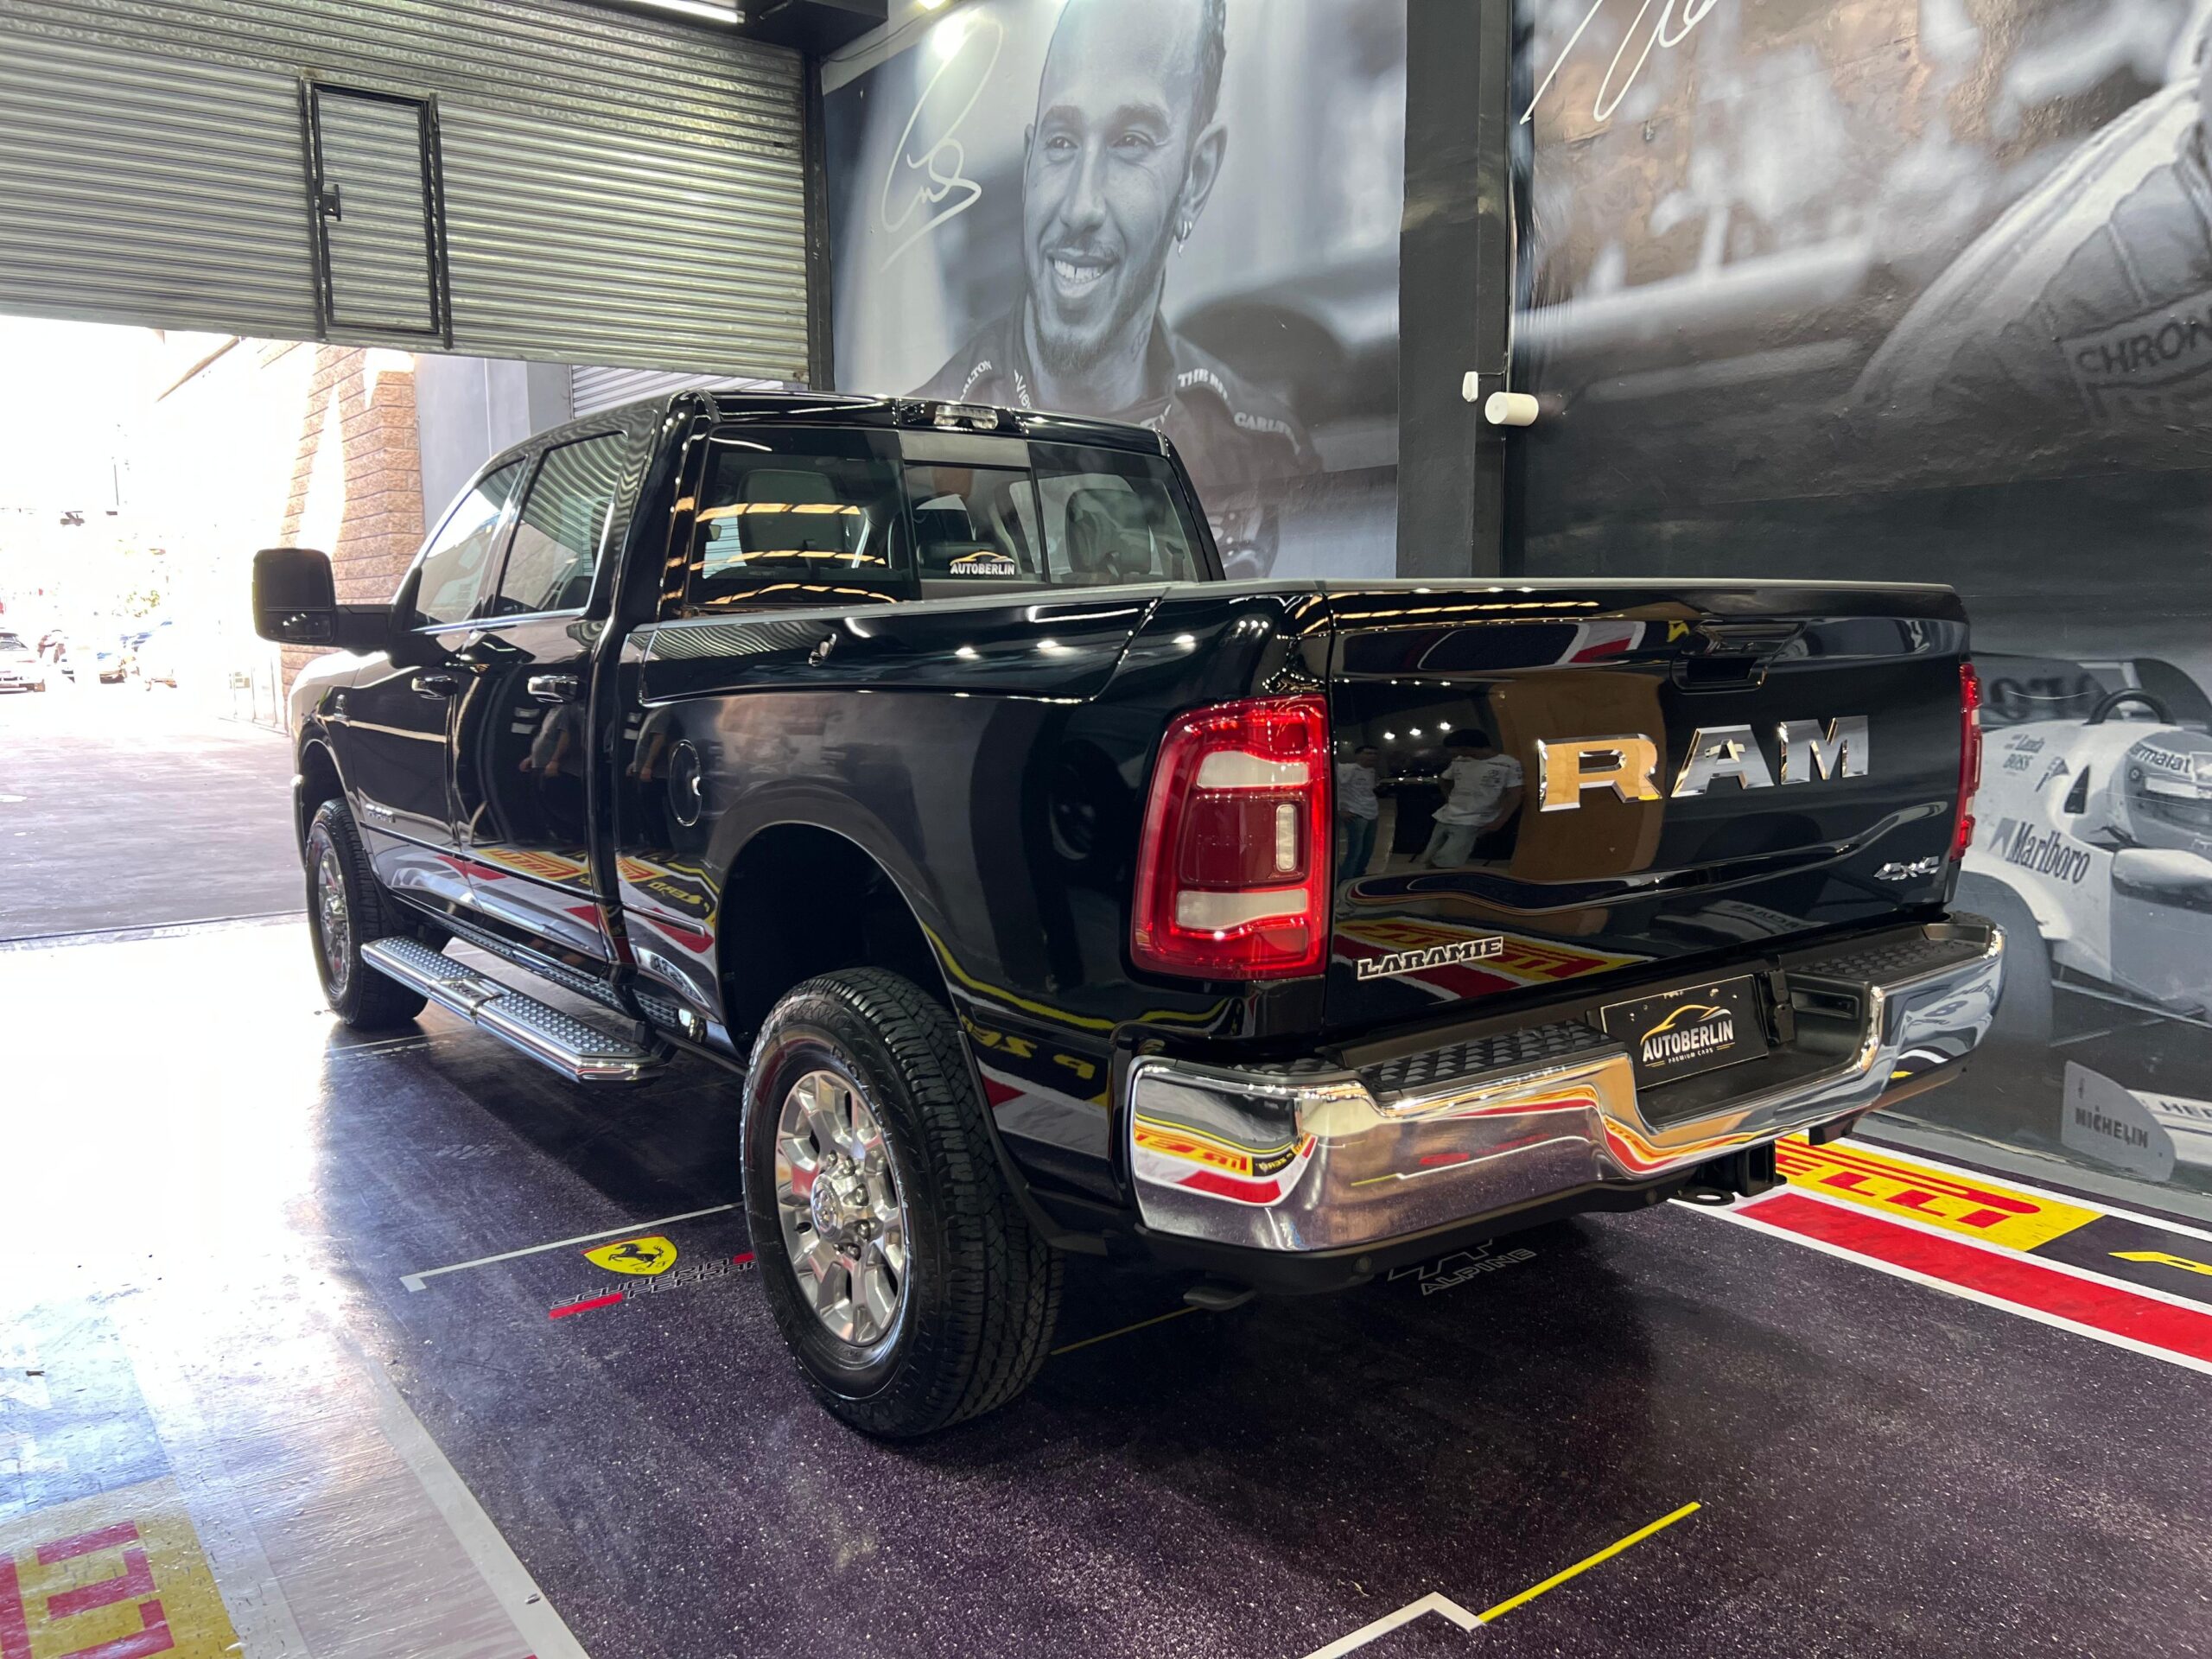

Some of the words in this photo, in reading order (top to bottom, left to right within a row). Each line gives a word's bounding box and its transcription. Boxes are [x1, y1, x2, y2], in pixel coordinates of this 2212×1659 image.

[950, 563, 1014, 575] AUTOBERLIN
[1537, 715, 1869, 812] RAM
[2005, 821, 2091, 884] Marlboro
[1357, 936, 1504, 982] LARAMIE
[1642, 1020, 1734, 1063] AUTOBERLIN
[1668, 1052, 1695, 1065] PREMIUM
[1697, 1046, 1714, 1057] CARS
[2075, 1105, 2149, 1149] MICHELIN
[550, 1257, 730, 1309] SCUDERIA
[1421, 1248, 1537, 1296] ALPINE
